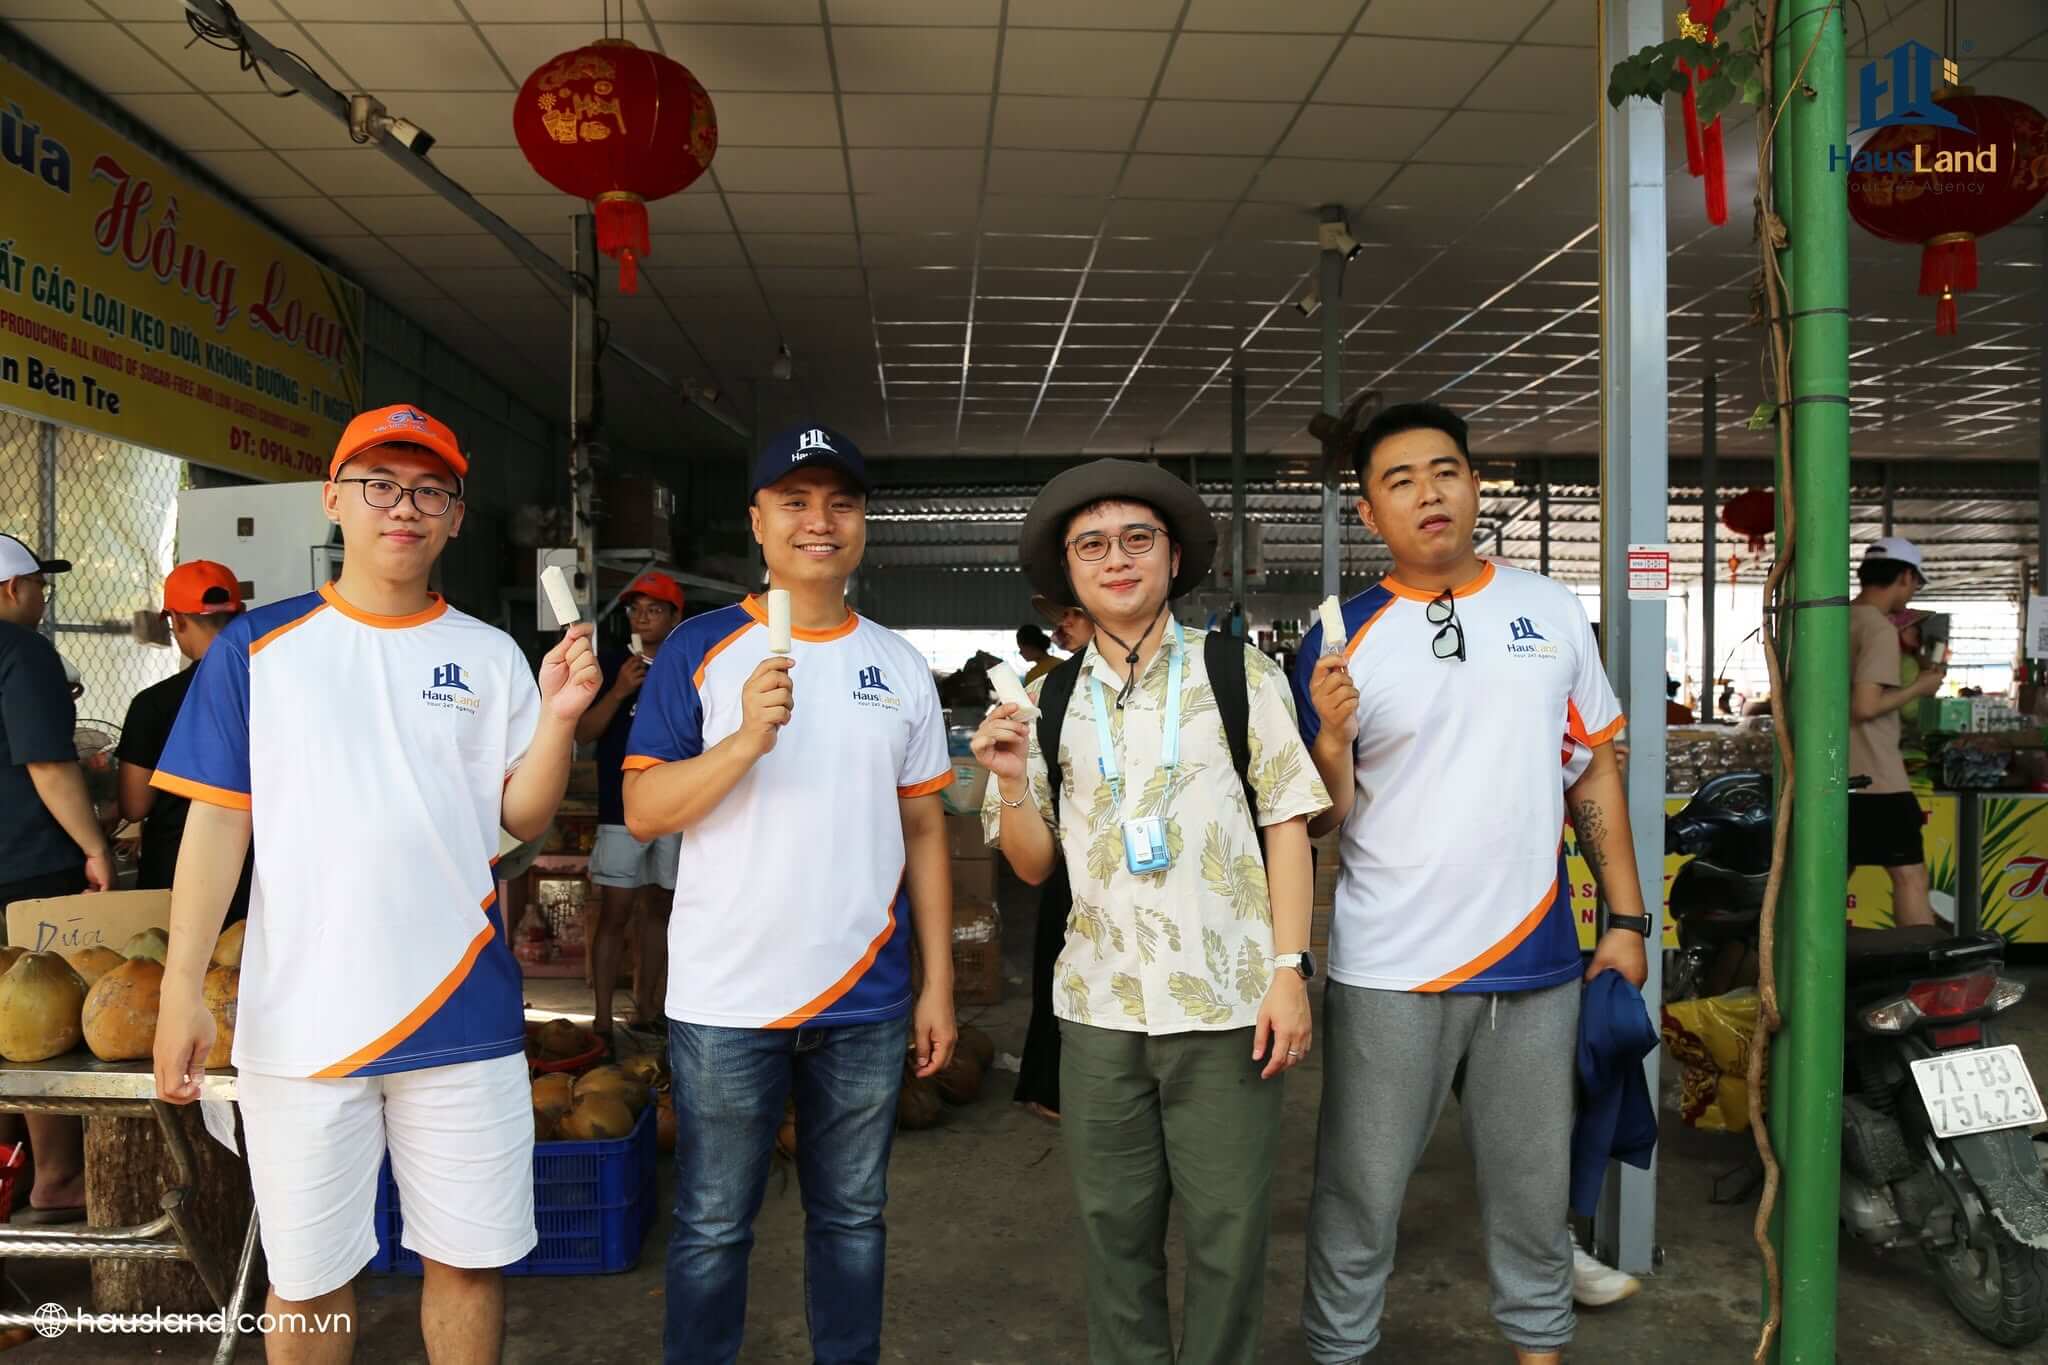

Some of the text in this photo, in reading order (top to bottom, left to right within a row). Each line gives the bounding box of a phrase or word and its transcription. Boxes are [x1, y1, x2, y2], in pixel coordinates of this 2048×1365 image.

[32, 266, 75, 314] CÁC
[82, 287, 125, 339] LOẠI
[131, 309, 165, 353] KẸO
[250, 261, 347, 366] Loan
[0, 309, 68, 352] PRODUCING
[71, 336, 90, 361] ALL
[82, 375, 119, 414] Tre
[422, 690, 480, 708] HausLand
[1929, 1054, 2011, 1095] 71-B3
[1932, 1086, 2036, 1131] 754.23
